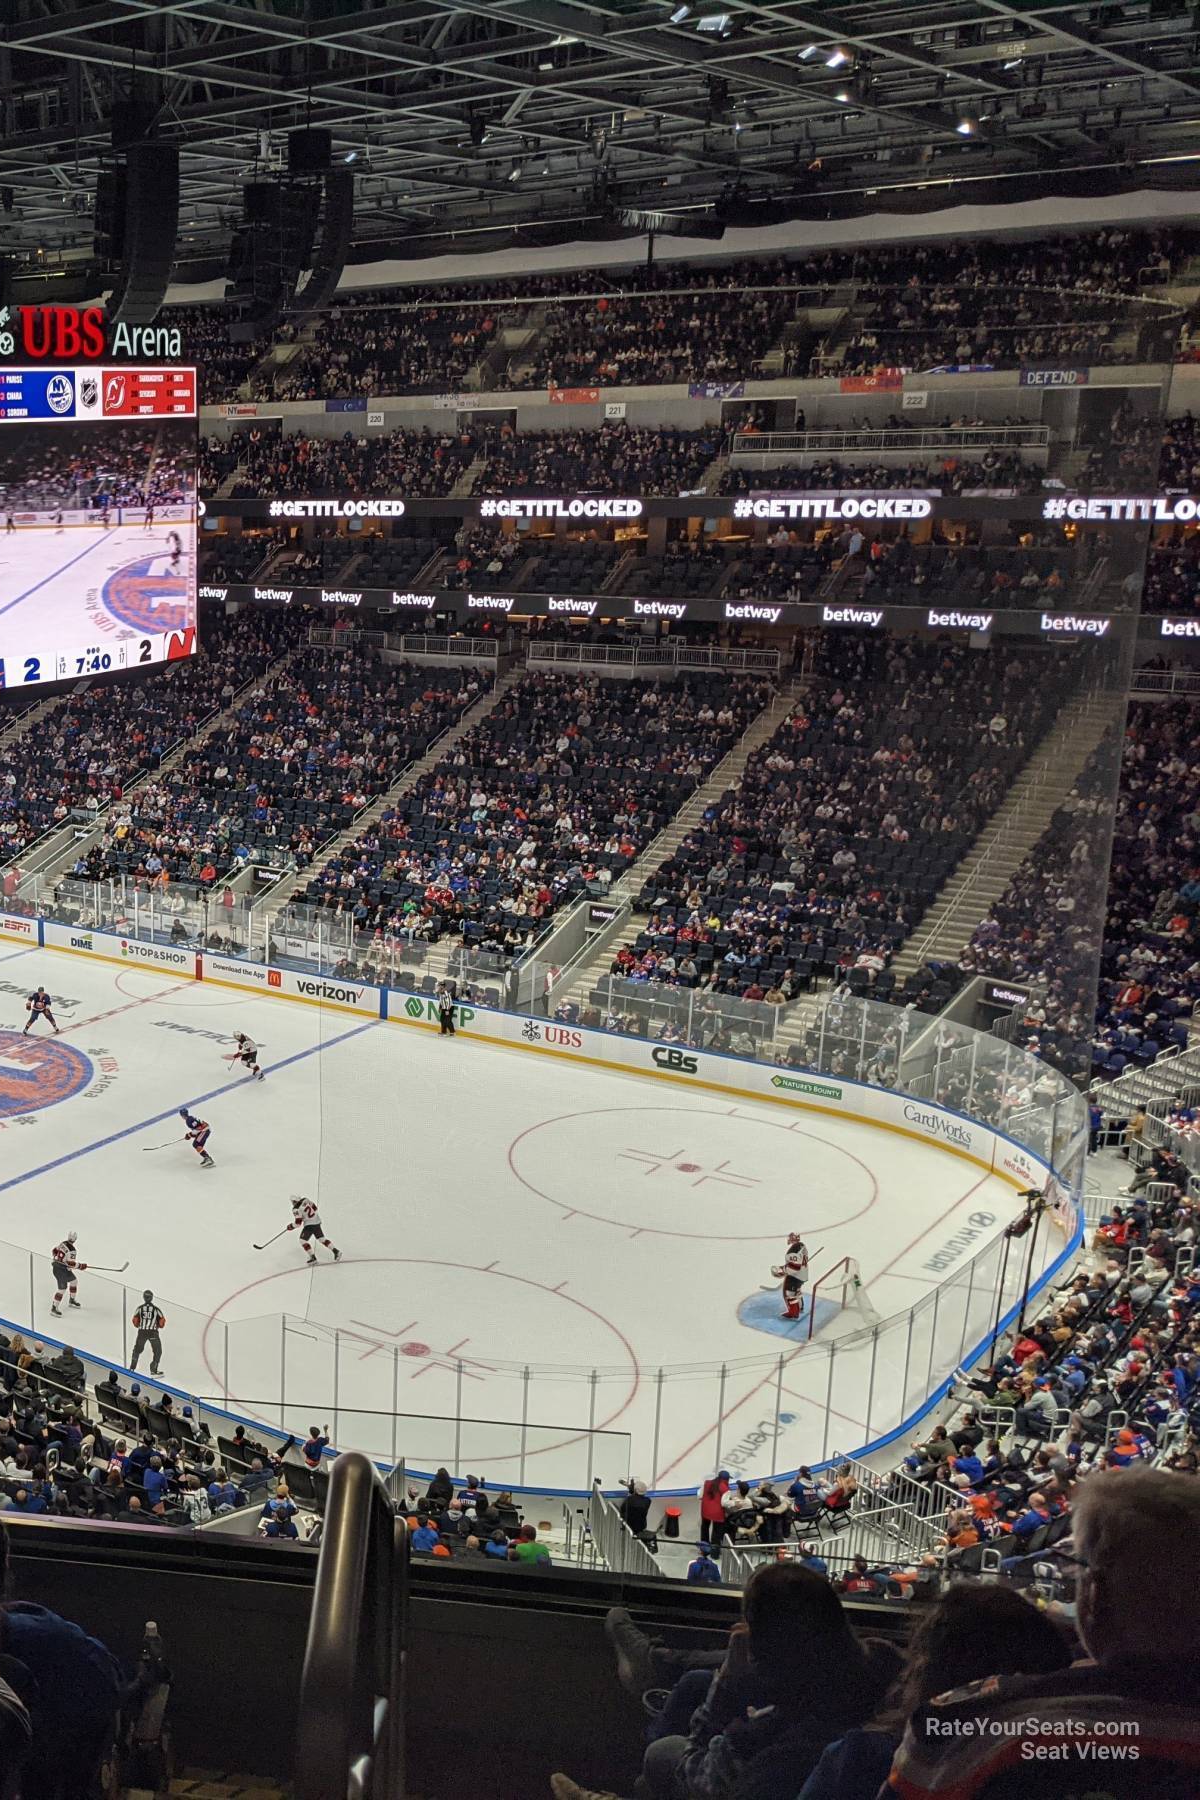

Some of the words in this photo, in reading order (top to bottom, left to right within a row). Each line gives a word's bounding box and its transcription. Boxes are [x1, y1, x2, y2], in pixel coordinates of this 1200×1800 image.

[17, 306, 106, 358] UBS
[112, 322, 182, 357] Arena
[1026, 370, 1077, 385] DEFEND
[369, 415, 382, 423] 220
[608, 405, 621, 415] 221
[269, 499, 405, 517] #GETITLOCKED
[480, 499, 643, 518] #GETITLOCKED
[734, 499, 931, 519] #GETITLOCKED
[1042, 498, 1200, 520] #GETITLO
[254, 588, 293, 602] betway
[321, 590, 362, 606] betway
[392, 592, 436, 609] betway
[467, 594, 514, 612] betway
[548, 597, 597, 615] betway
[634, 600, 687, 619] betway
[725, 602, 782, 622] betway
[822, 606, 883, 626] betway
[927, 610, 993, 631] betway
[1040, 614, 1110, 636] betway
[139, 640, 153, 662] 2
[24, 658, 41, 682] 2
[59, 663, 66, 674] 12
[75, 653, 112, 674] 7:40
[4, 919, 32, 933] ESPN
[71, 936, 93, 950] DIME
[127, 945, 187, 965] STOP&SHOP
[212, 962, 241, 975] Download
[241, 967, 252, 976] the
[252, 969, 266, 980] App
[296, 979, 357, 1004] verizon
[992, 987, 1028, 1004] betway
[544, 1026, 583, 1049] UBS
[97, 1056, 120, 1078] UBS
[651, 1046, 698, 1074] CBS
[82, 1074, 119, 1099] Arena
[781, 1079, 813, 1094] NATURE'S
[813, 1084, 841, 1098] BOUNTY
[903, 1103, 972, 1144] CardWorks
[719, 1420, 786, 1472] Dental
